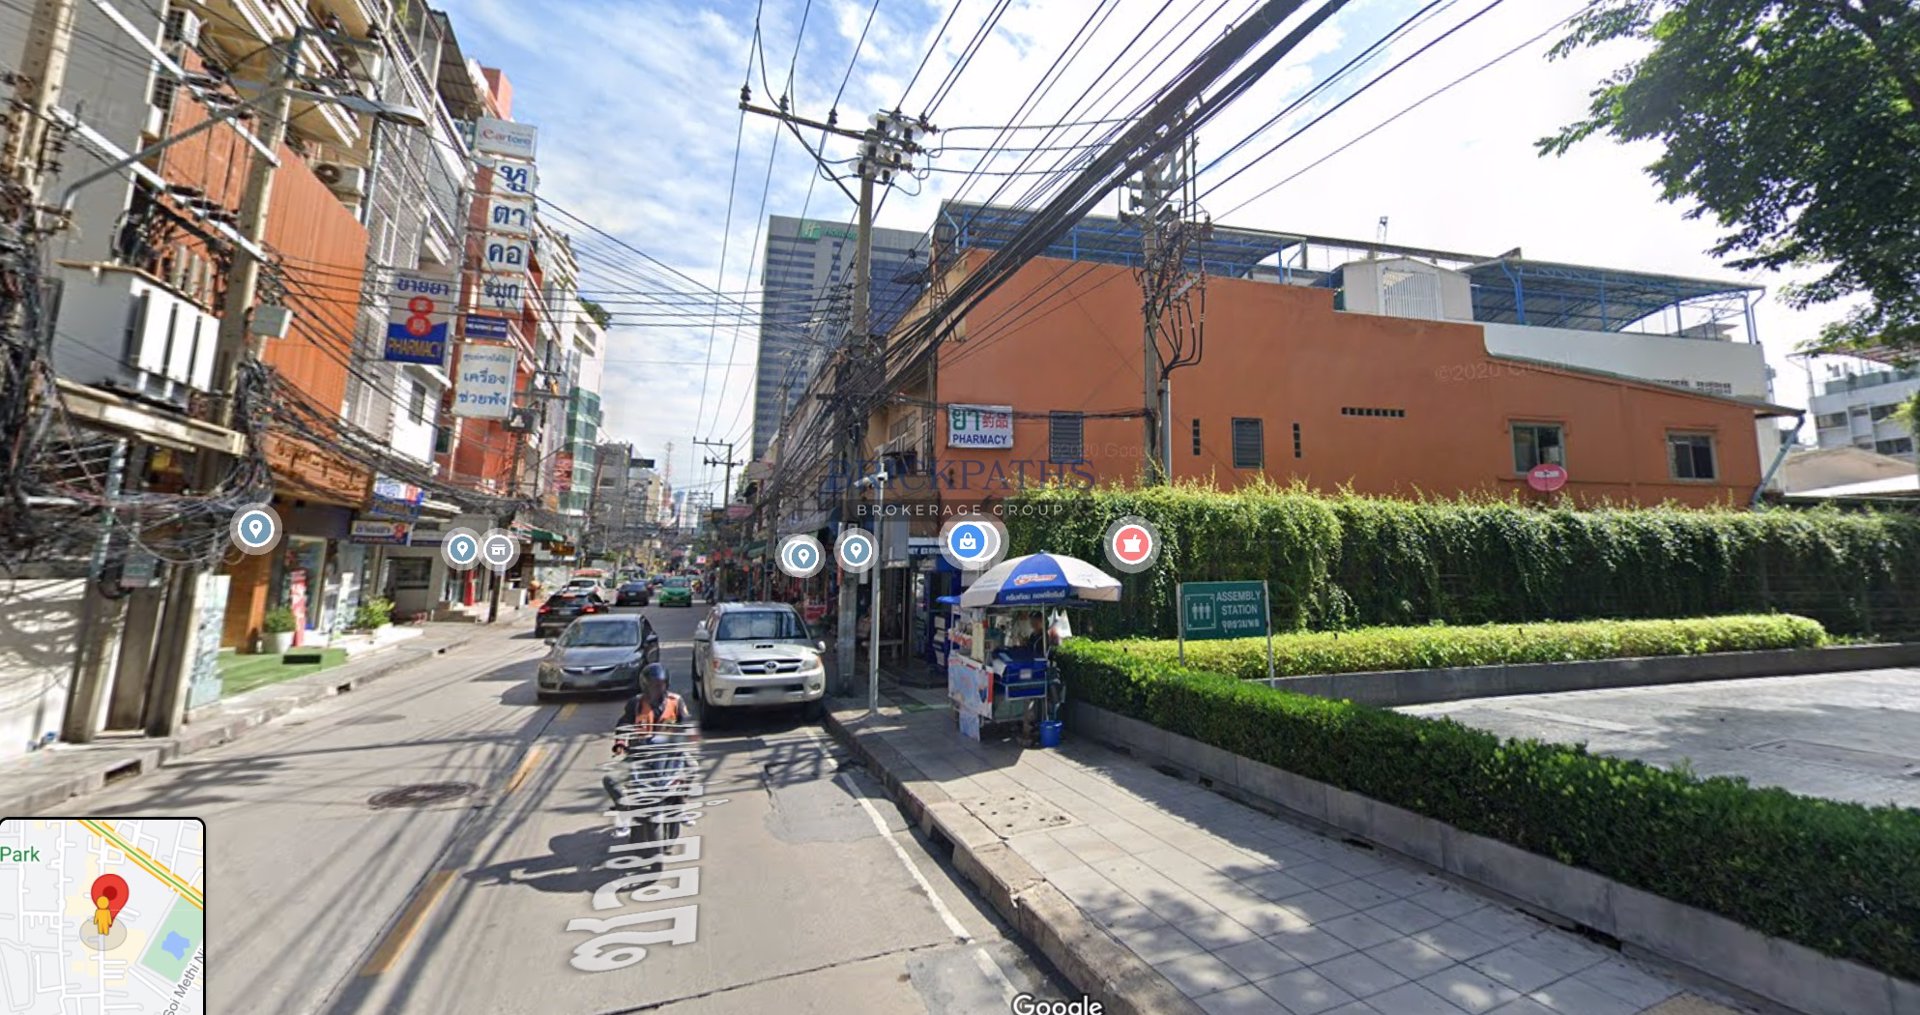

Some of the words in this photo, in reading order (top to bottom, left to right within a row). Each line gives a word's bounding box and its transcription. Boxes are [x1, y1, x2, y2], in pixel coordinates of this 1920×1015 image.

[500, 165, 528, 193] หู
[493, 205, 526, 226] ตา
[488, 243, 522, 265] คอ
[397, 278, 449, 295] ขายยา
[484, 281, 519, 308] จมูก
[463, 368, 506, 384] เครื่อง
[952, 408, 979, 431] ยา
[952, 434, 1007, 445] PHARMACY
[1216, 590, 1261, 602] ASSEMBLY
[1221, 603, 1258, 616] STATION
